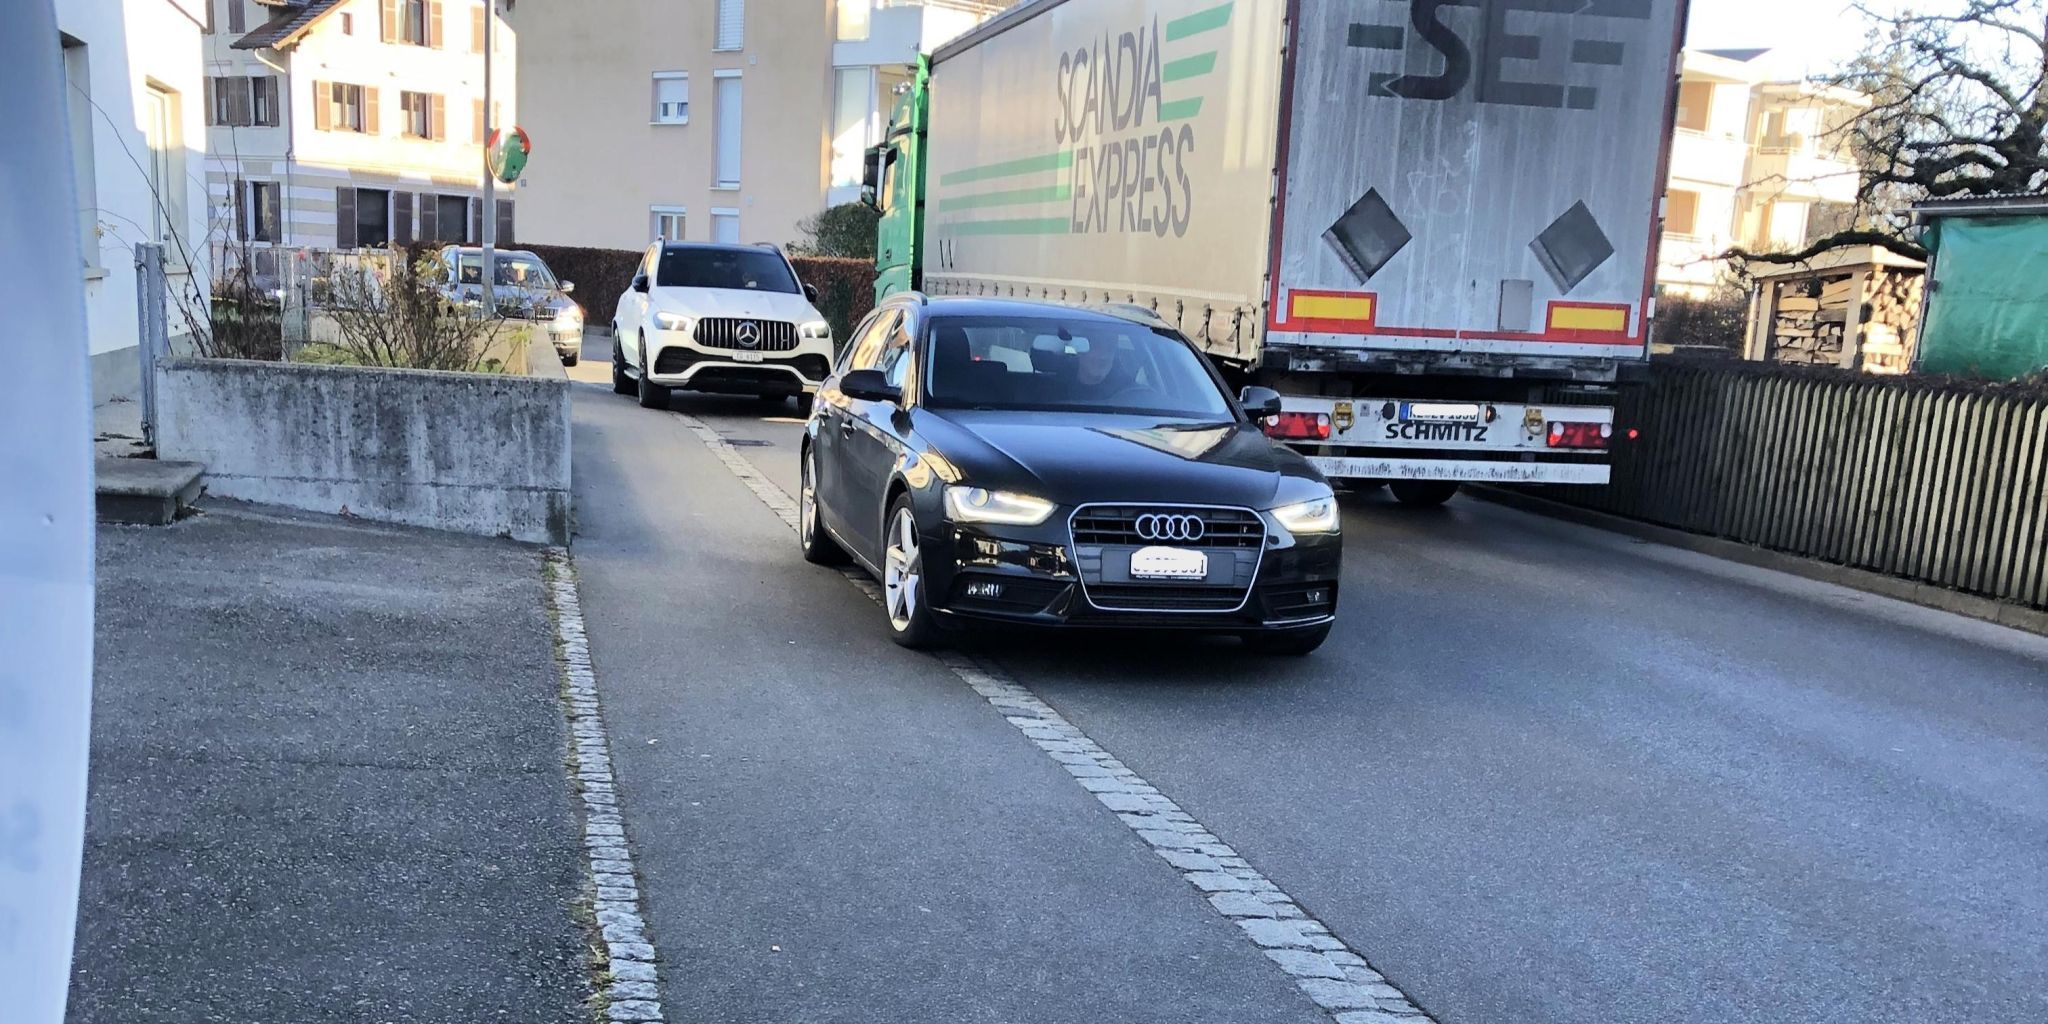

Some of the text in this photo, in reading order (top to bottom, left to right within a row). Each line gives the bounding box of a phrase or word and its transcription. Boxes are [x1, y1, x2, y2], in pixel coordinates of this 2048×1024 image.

[1055, 10, 1162, 144] SCANDIA
[1072, 123, 1194, 238] EXPRESS
[1385, 422, 1488, 442] SCHMITZ
